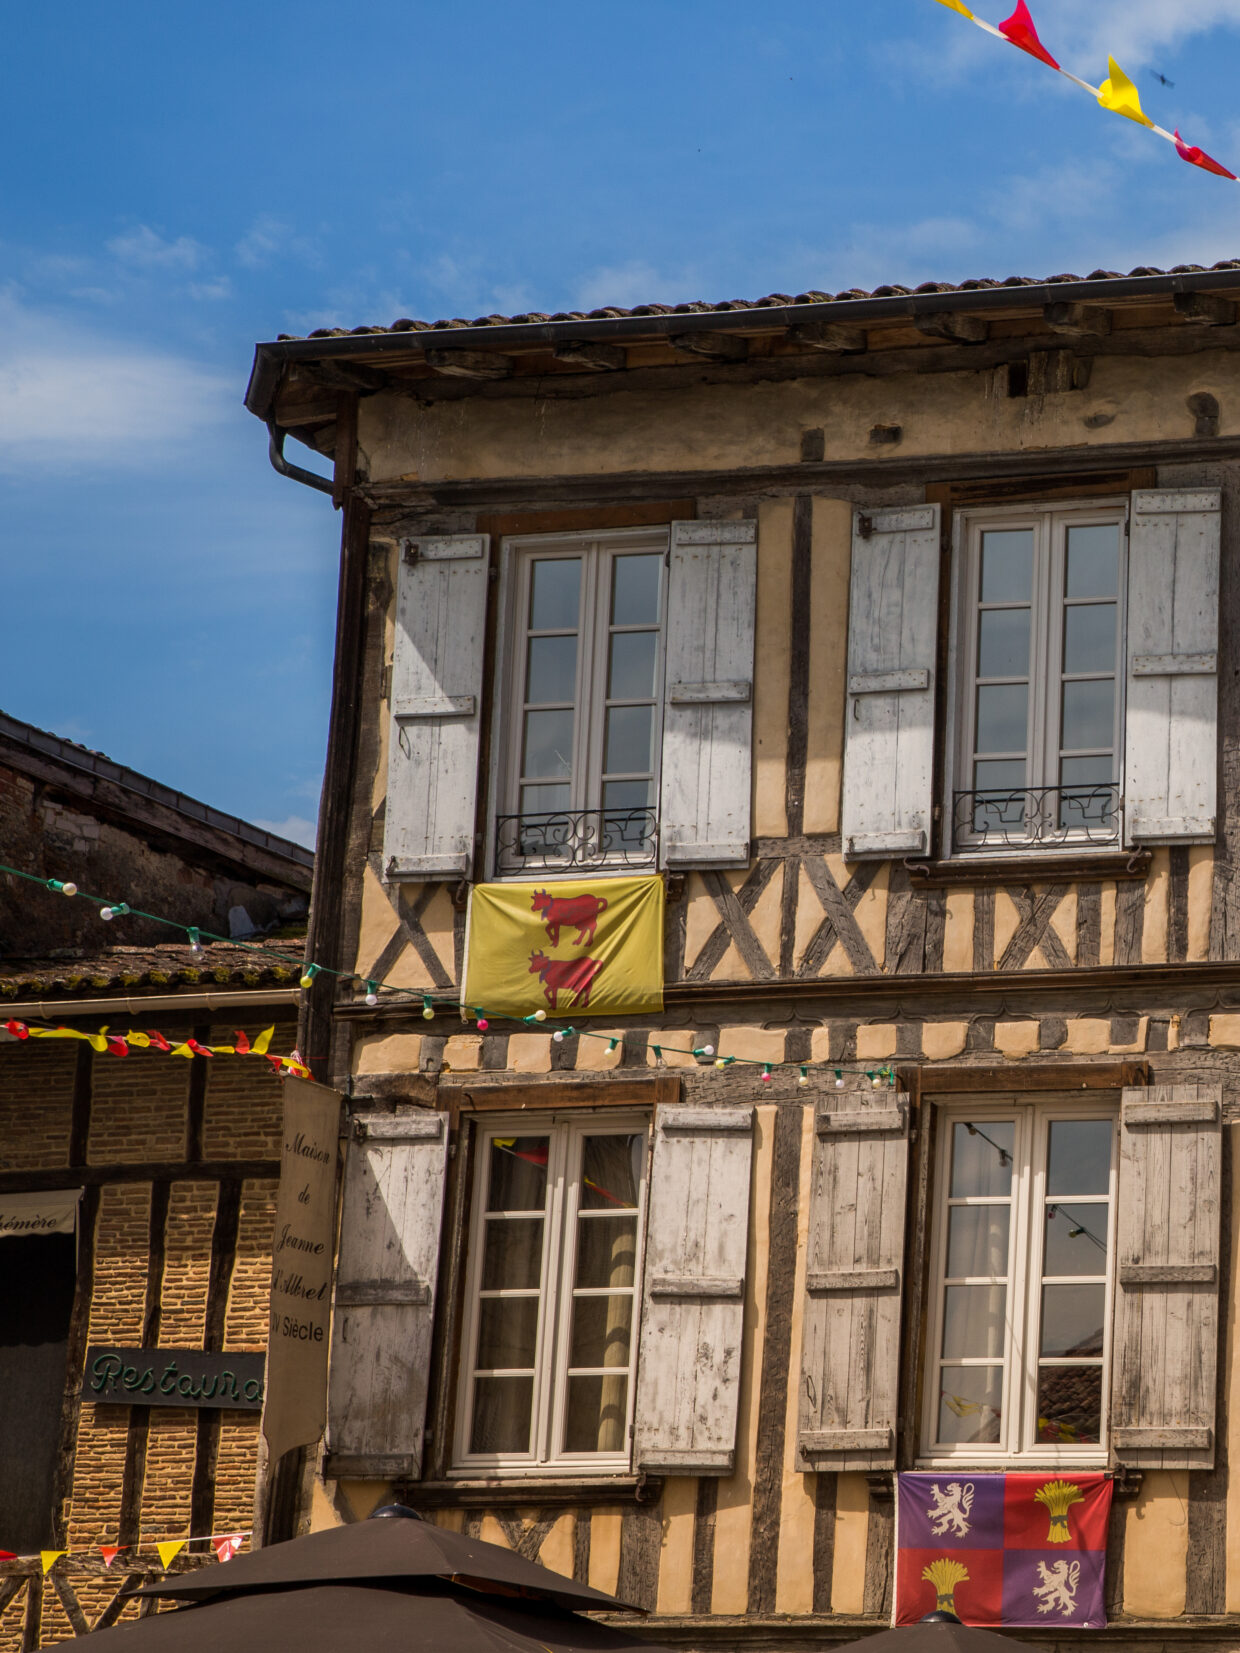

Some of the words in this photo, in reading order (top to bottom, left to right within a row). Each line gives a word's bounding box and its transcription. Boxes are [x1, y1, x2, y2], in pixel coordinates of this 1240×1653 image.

[285, 1132, 330, 1165] Maison
[297, 1183, 310, 1206] de
[276, 1223, 326, 1255] Jeanne
[282, 1316, 324, 1342] Siècle
